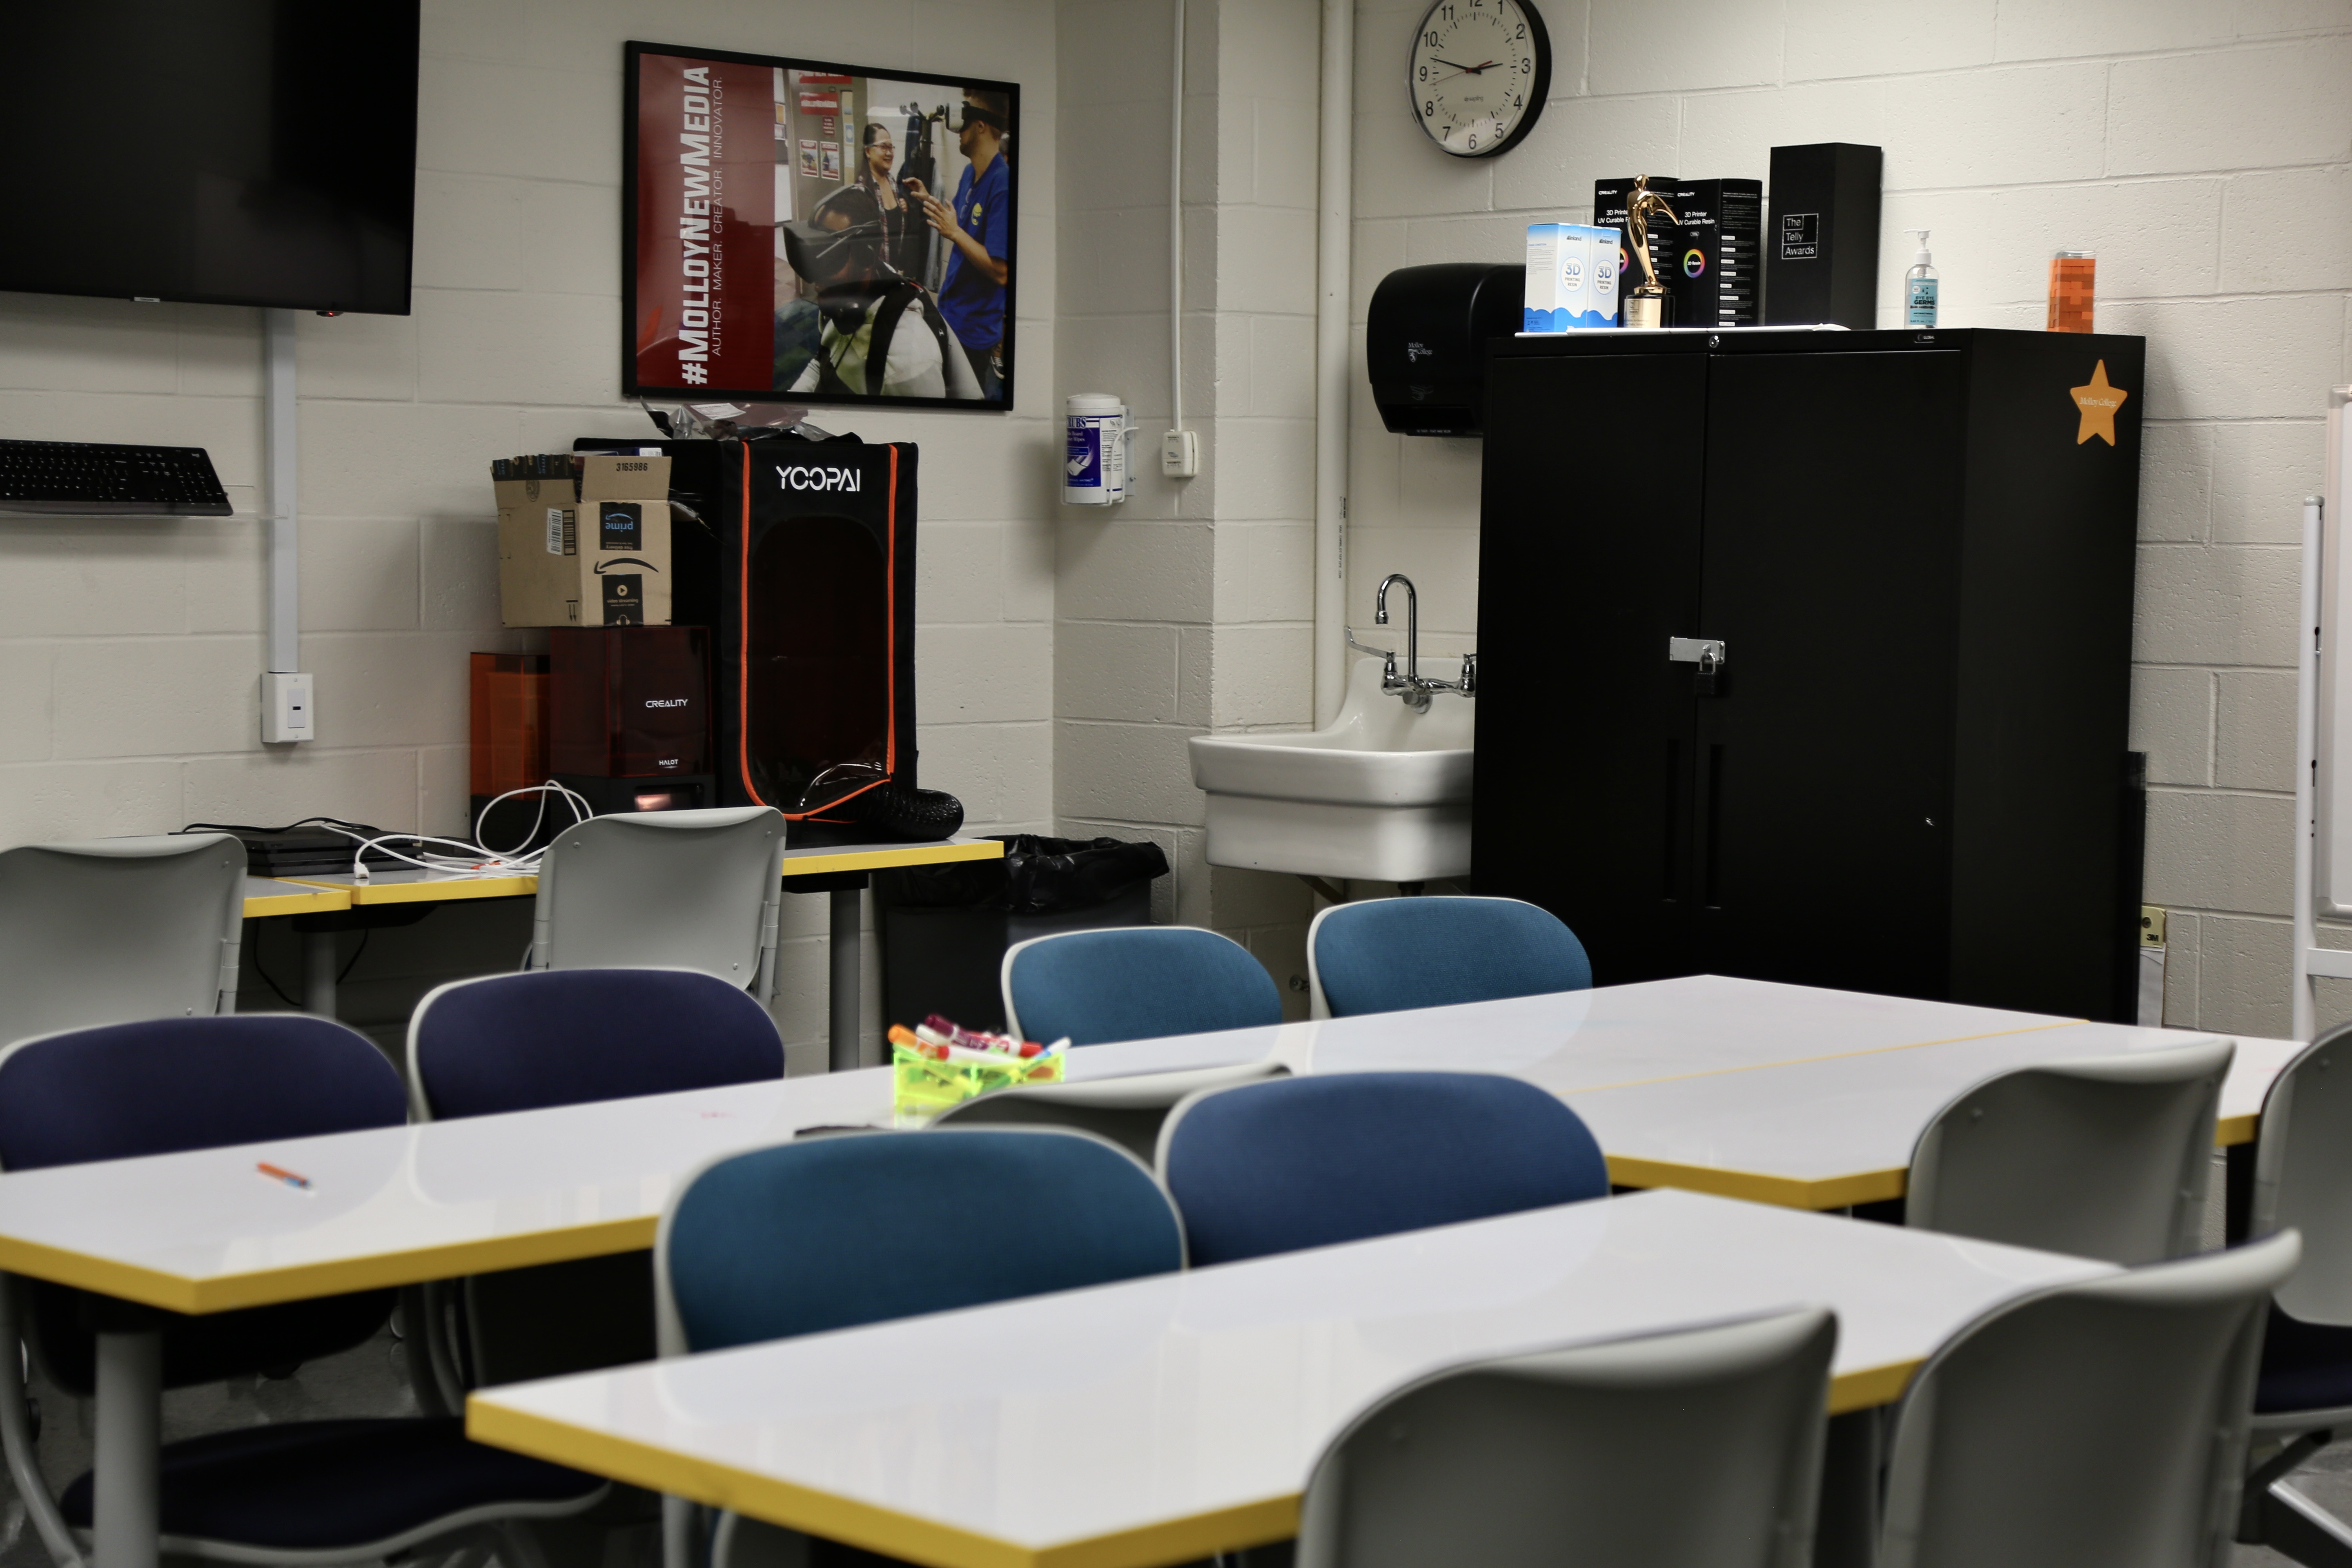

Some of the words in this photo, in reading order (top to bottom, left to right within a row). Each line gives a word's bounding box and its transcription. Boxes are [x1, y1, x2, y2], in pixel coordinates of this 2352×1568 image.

[1441, 5, 1454, 20] 11
[1498, 0, 1503, 14] 1
[1423, 31, 1438, 47] 10
[1516, 24, 1525, 39] 2
[1521, 58, 1531, 74] 3
[1419, 66, 1428, 82] 9
[1425, 101, 1434, 116] 8
[1514, 94, 1523, 110] 4
[713, 77, 723, 159] INNOVATOR.
[1443, 126, 1451, 141] 7
[1495, 123, 1504, 139] 5
[1468, 134, 1477, 149] 6
[713, 167, 722, 234] CREATOR.
[1786, 218, 1801, 227] The
[1785, 232, 1804, 243] Telly
[1785, 245, 1815, 256] Awards
[713, 241, 722, 291] MAKER.
[1565, 263, 1581, 275] 3D
[1598, 266, 1612, 278] 3D
[712, 298, 722, 356] AUTHOR.
[2079, 397, 2098, 407] Molloy
[2098, 398, 2117, 408] College
[616, 462, 648, 472] 3165986
[776, 466, 860, 492] YOOPAI
[605, 521, 634, 532] prime
[646, 699, 688, 708] CREALITY
[2147, 933, 2159, 942] 3M
